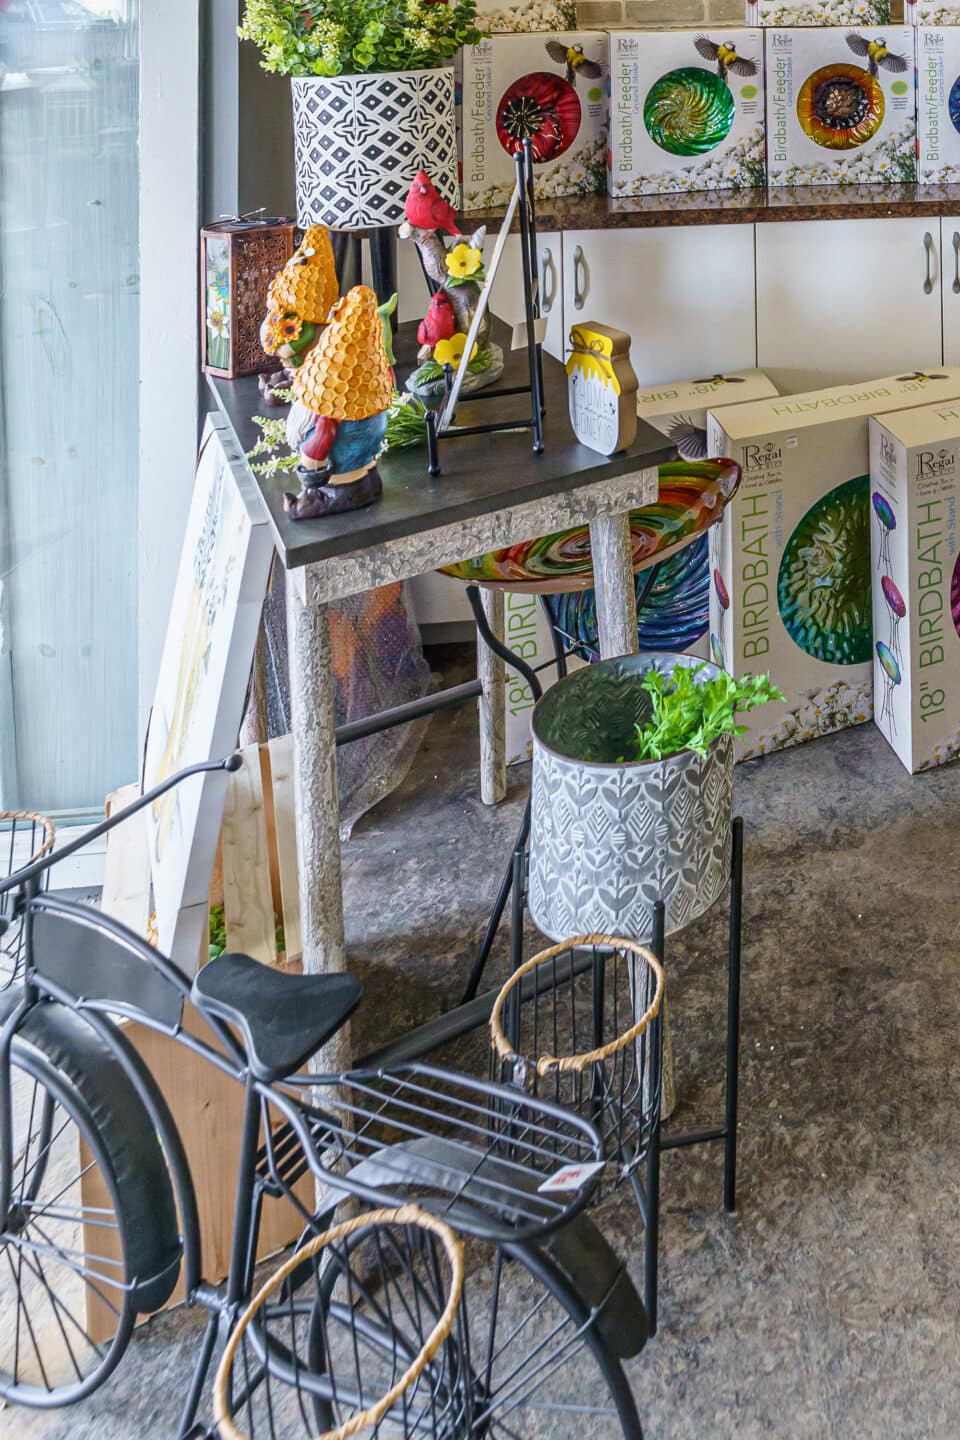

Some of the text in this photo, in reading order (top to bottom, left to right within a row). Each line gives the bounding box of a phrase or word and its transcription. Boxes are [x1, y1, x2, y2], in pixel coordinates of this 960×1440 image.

[471, 68, 485, 181] Birdbath/Feeder
[620, 62, 632, 172] Birdbath/Feeder
[774, 56, 786, 162] Birdbath/Feeder
[926, 56, 938, 162] Birdbath/Feeder
[637, 390, 679, 404] BIR
[741, 443, 782, 471] Regal
[915, 452, 954, 475] Regal
[741, 494, 769, 659] BIRDBATH
[917, 499, 944, 672] BIRDBATH
[919, 680, 945, 723] 18"
